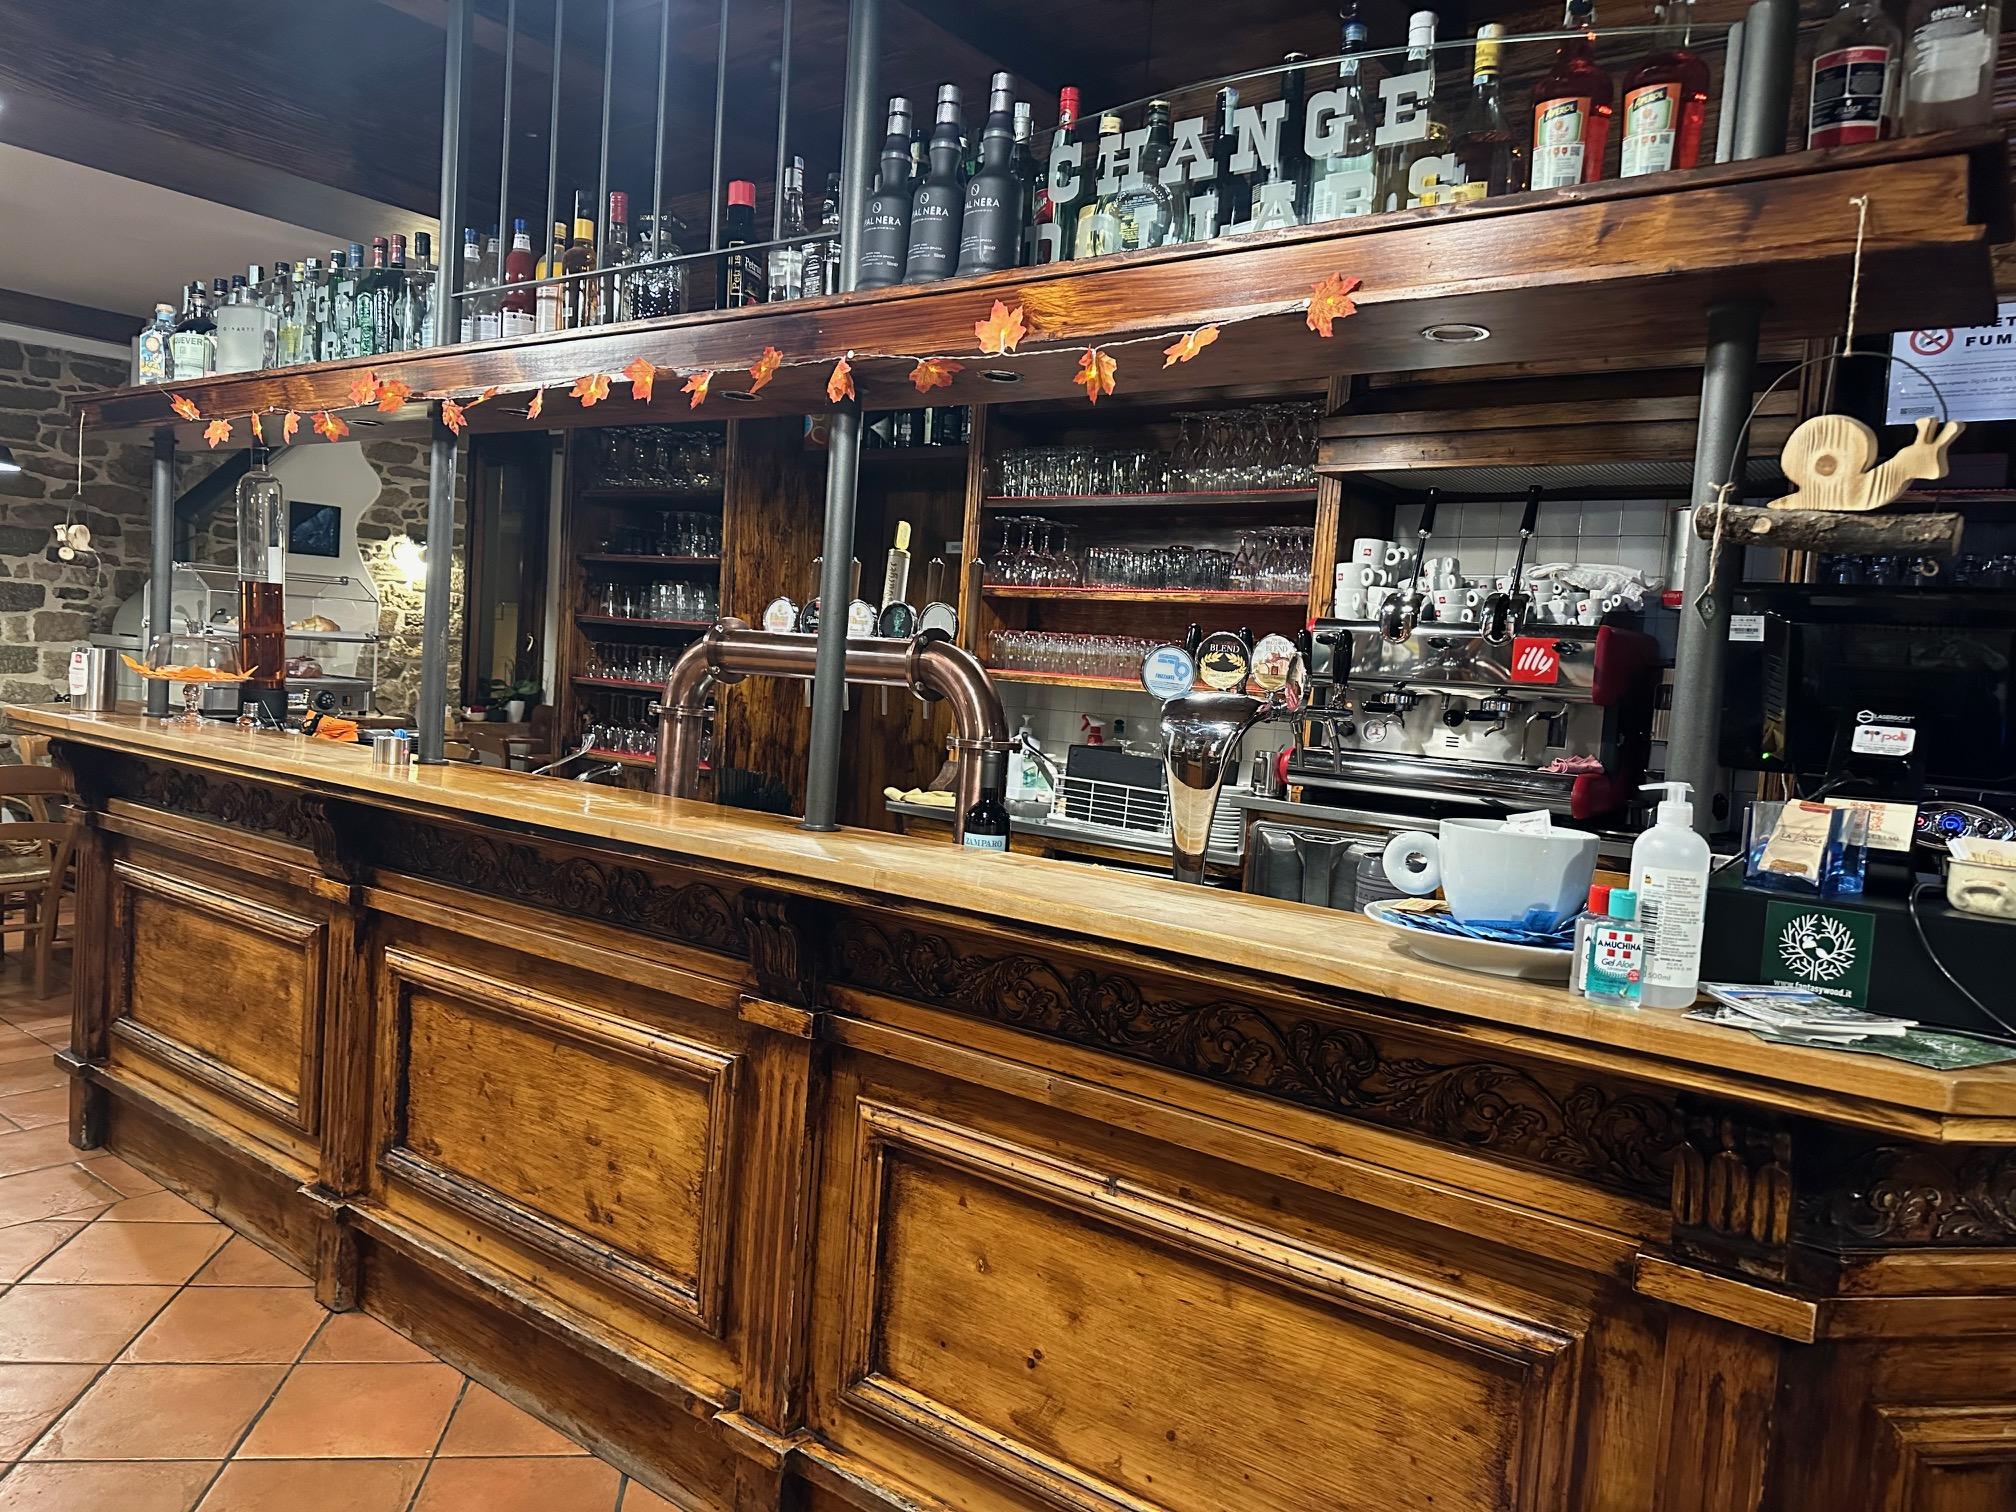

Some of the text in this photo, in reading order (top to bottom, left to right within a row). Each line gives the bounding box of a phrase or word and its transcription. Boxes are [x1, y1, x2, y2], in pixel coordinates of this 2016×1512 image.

[1049, 70, 1432, 204] CHANGE
[973, 197, 1000, 208] NERA
[922, 205, 949, 217] NERA
[875, 215, 902, 227] NERA
[1965, 333, 2016, 347] FUM
[1209, 643, 1240, 653] BLEND
[1516, 647, 1555, 675] illy
[1597, 939, 1641, 952] AMUCHINA
[1601, 957, 1635, 968] Gel Aloe
[1773, 977, 1853, 999] www.fantasywood.it
